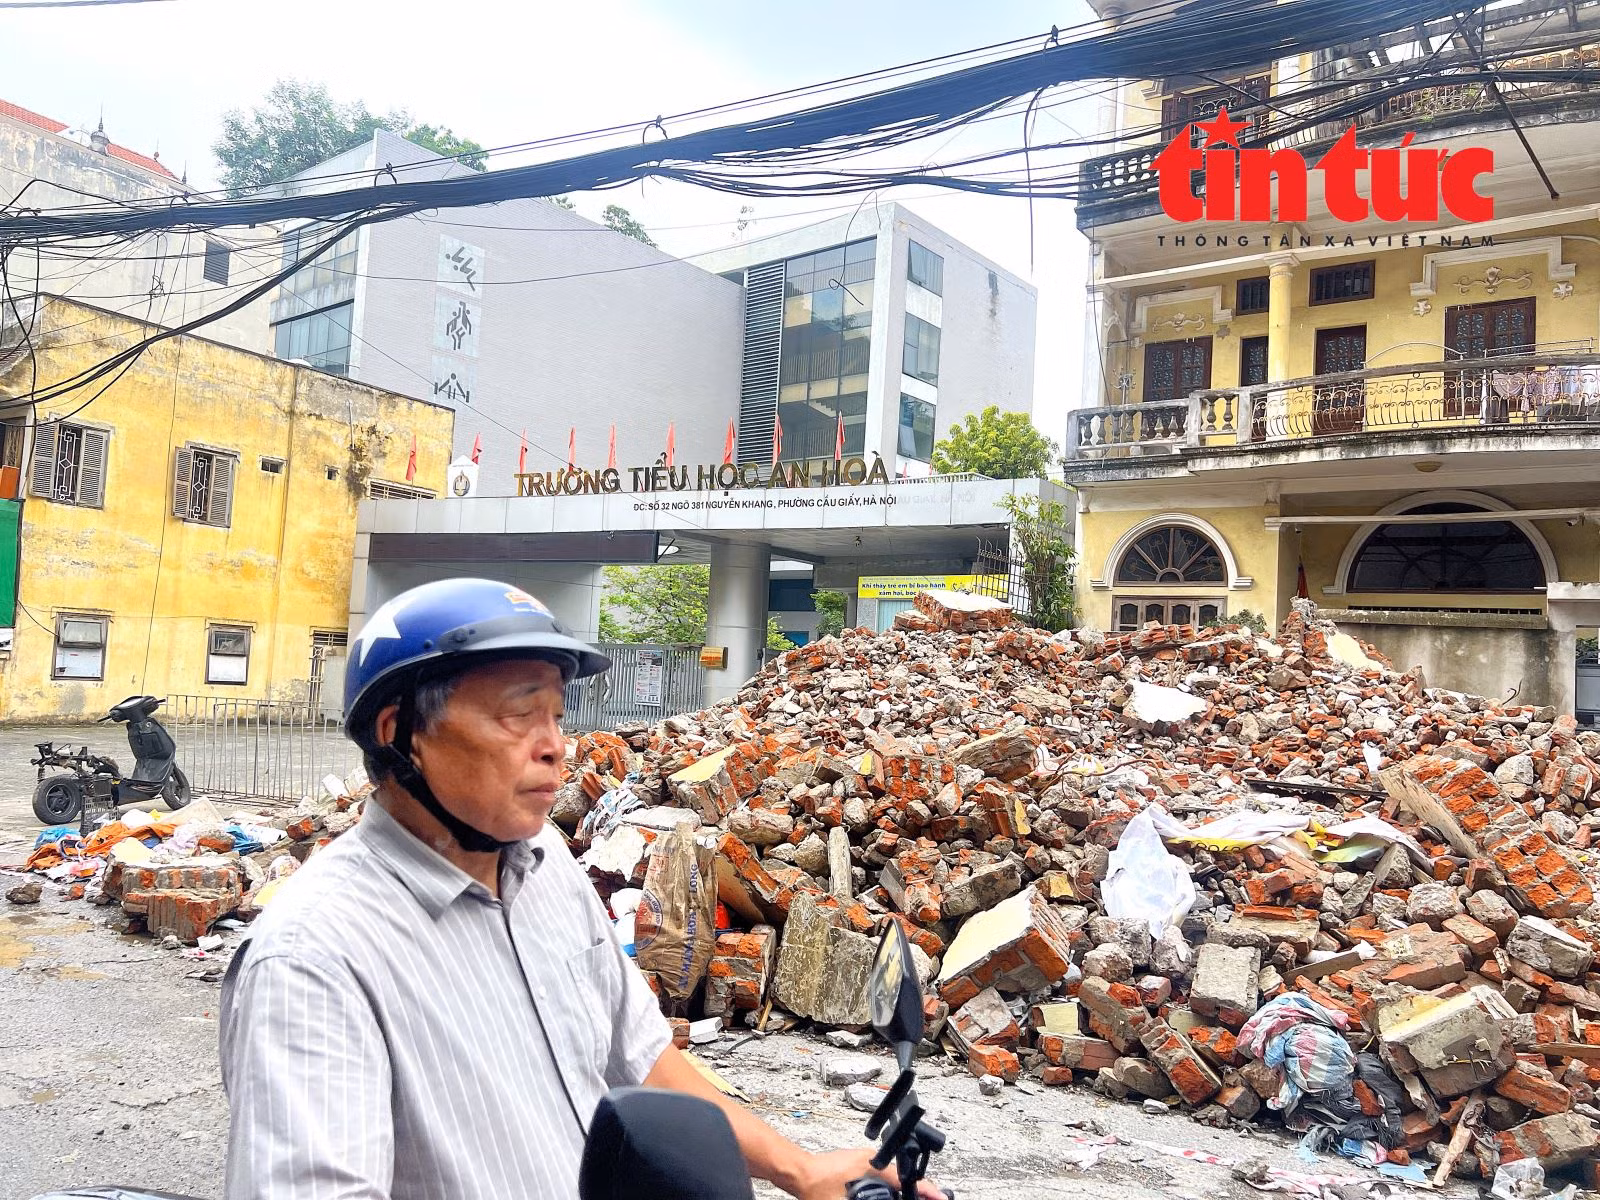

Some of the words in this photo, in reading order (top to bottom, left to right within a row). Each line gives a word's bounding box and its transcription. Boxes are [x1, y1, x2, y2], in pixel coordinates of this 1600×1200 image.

[628, 451, 687, 492] TIỂU
[697, 462, 760, 496] HỌC
[767, 460, 810, 489] AN
[821, 450, 890, 488] HOÀ
[661, 502, 671, 511] 32
[691, 501, 704, 510] 381
[778, 496, 815, 508] PHƯỜNG
[816, 494, 837, 508] CẦU
[863, 494, 877, 506] HÀ
[879, 493, 897, 508] NỘI
